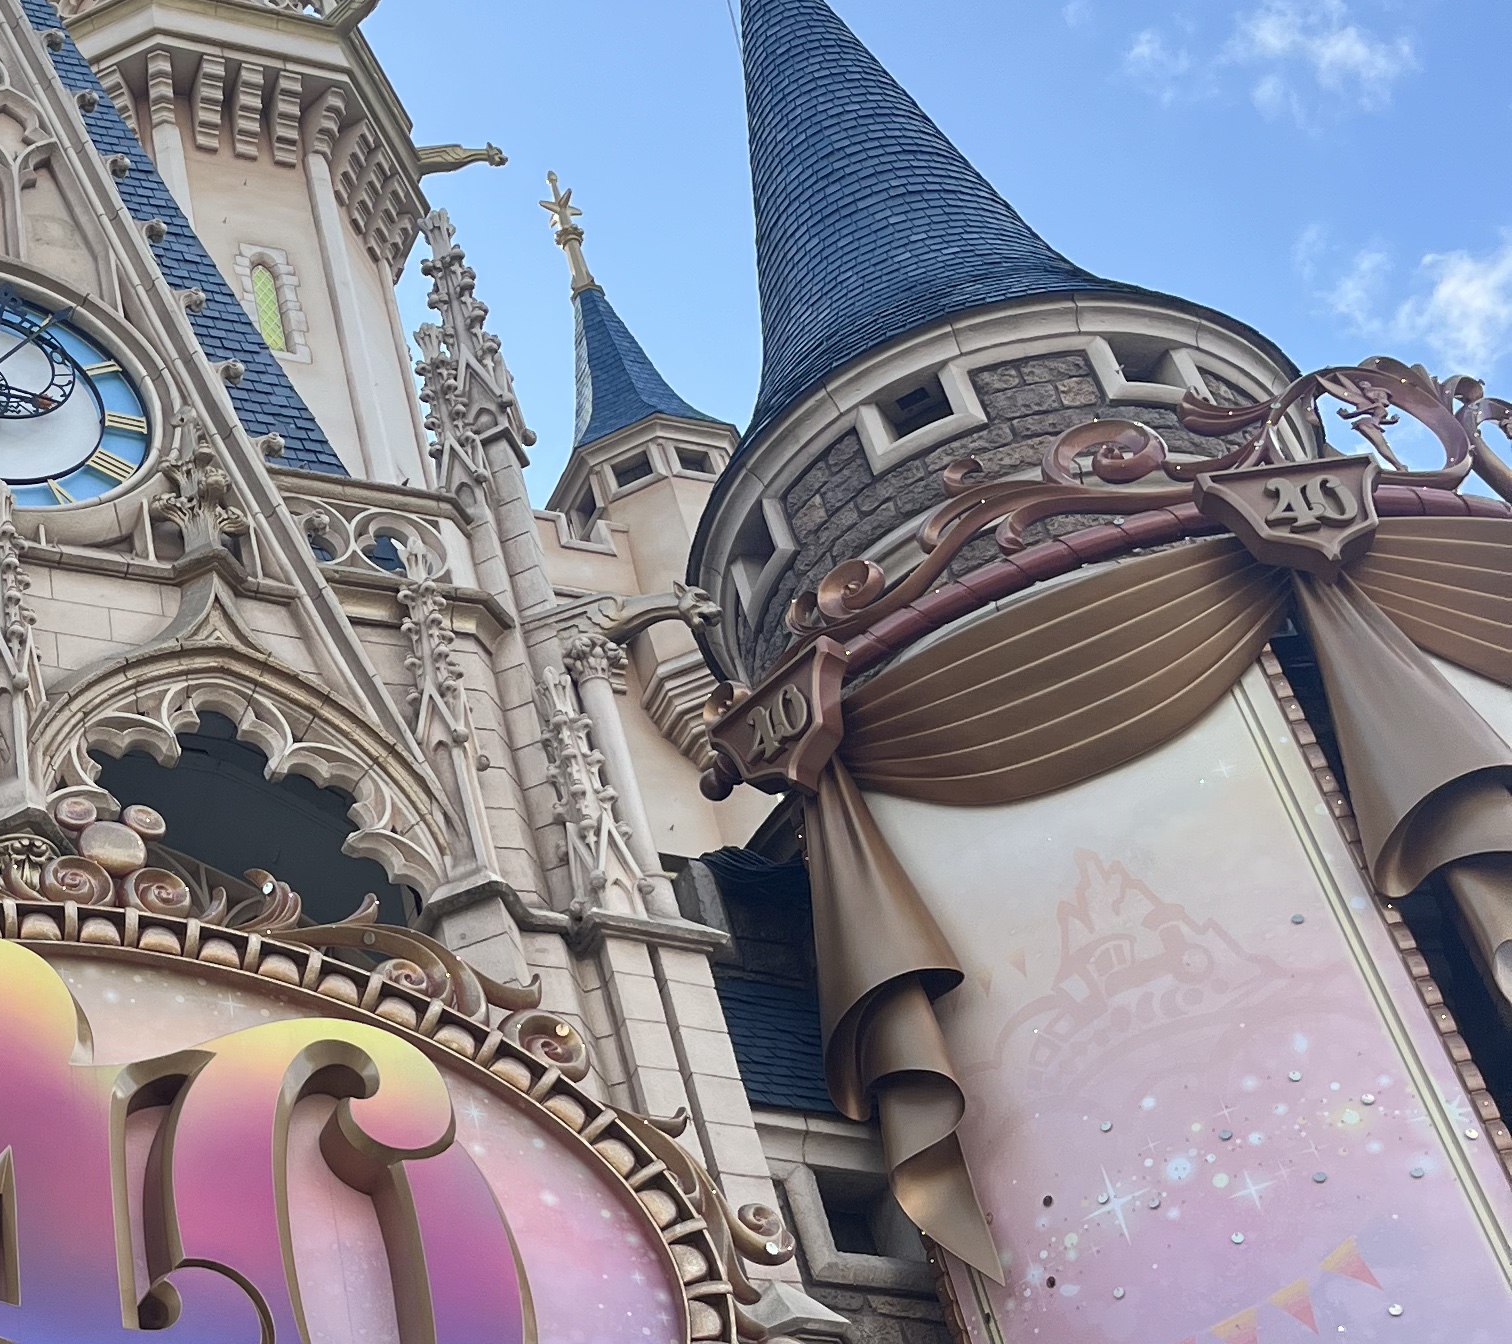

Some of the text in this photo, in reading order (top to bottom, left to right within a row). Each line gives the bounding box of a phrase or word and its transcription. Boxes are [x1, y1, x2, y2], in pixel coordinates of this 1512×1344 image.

[104, 411, 148, 434] III
[1264, 474, 1358, 533] 40
[747, 683, 809, 764] 40
